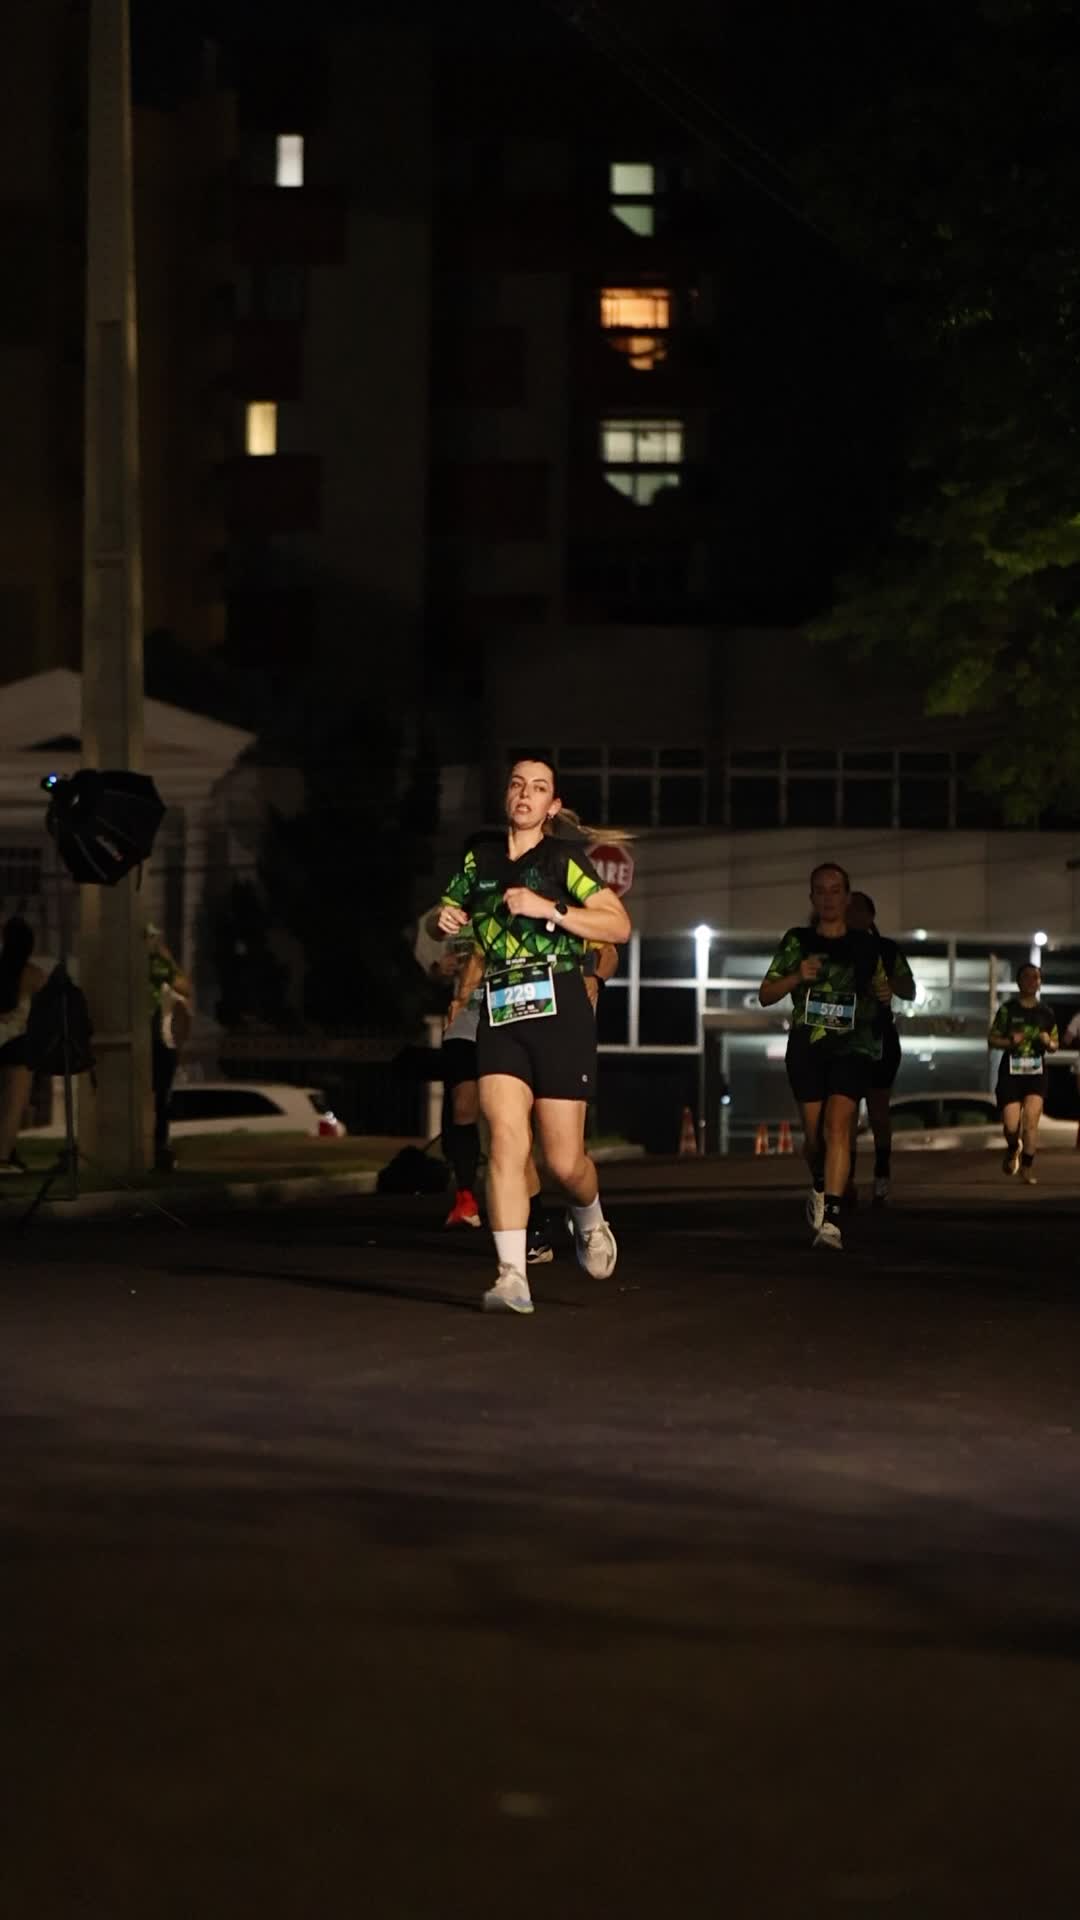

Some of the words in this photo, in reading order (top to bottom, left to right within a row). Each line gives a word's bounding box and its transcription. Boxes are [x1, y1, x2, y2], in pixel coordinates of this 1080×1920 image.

[593, 859, 629, 885] ARE
[504, 983, 536, 1005] 229
[821, 1003, 844, 1017] 579
